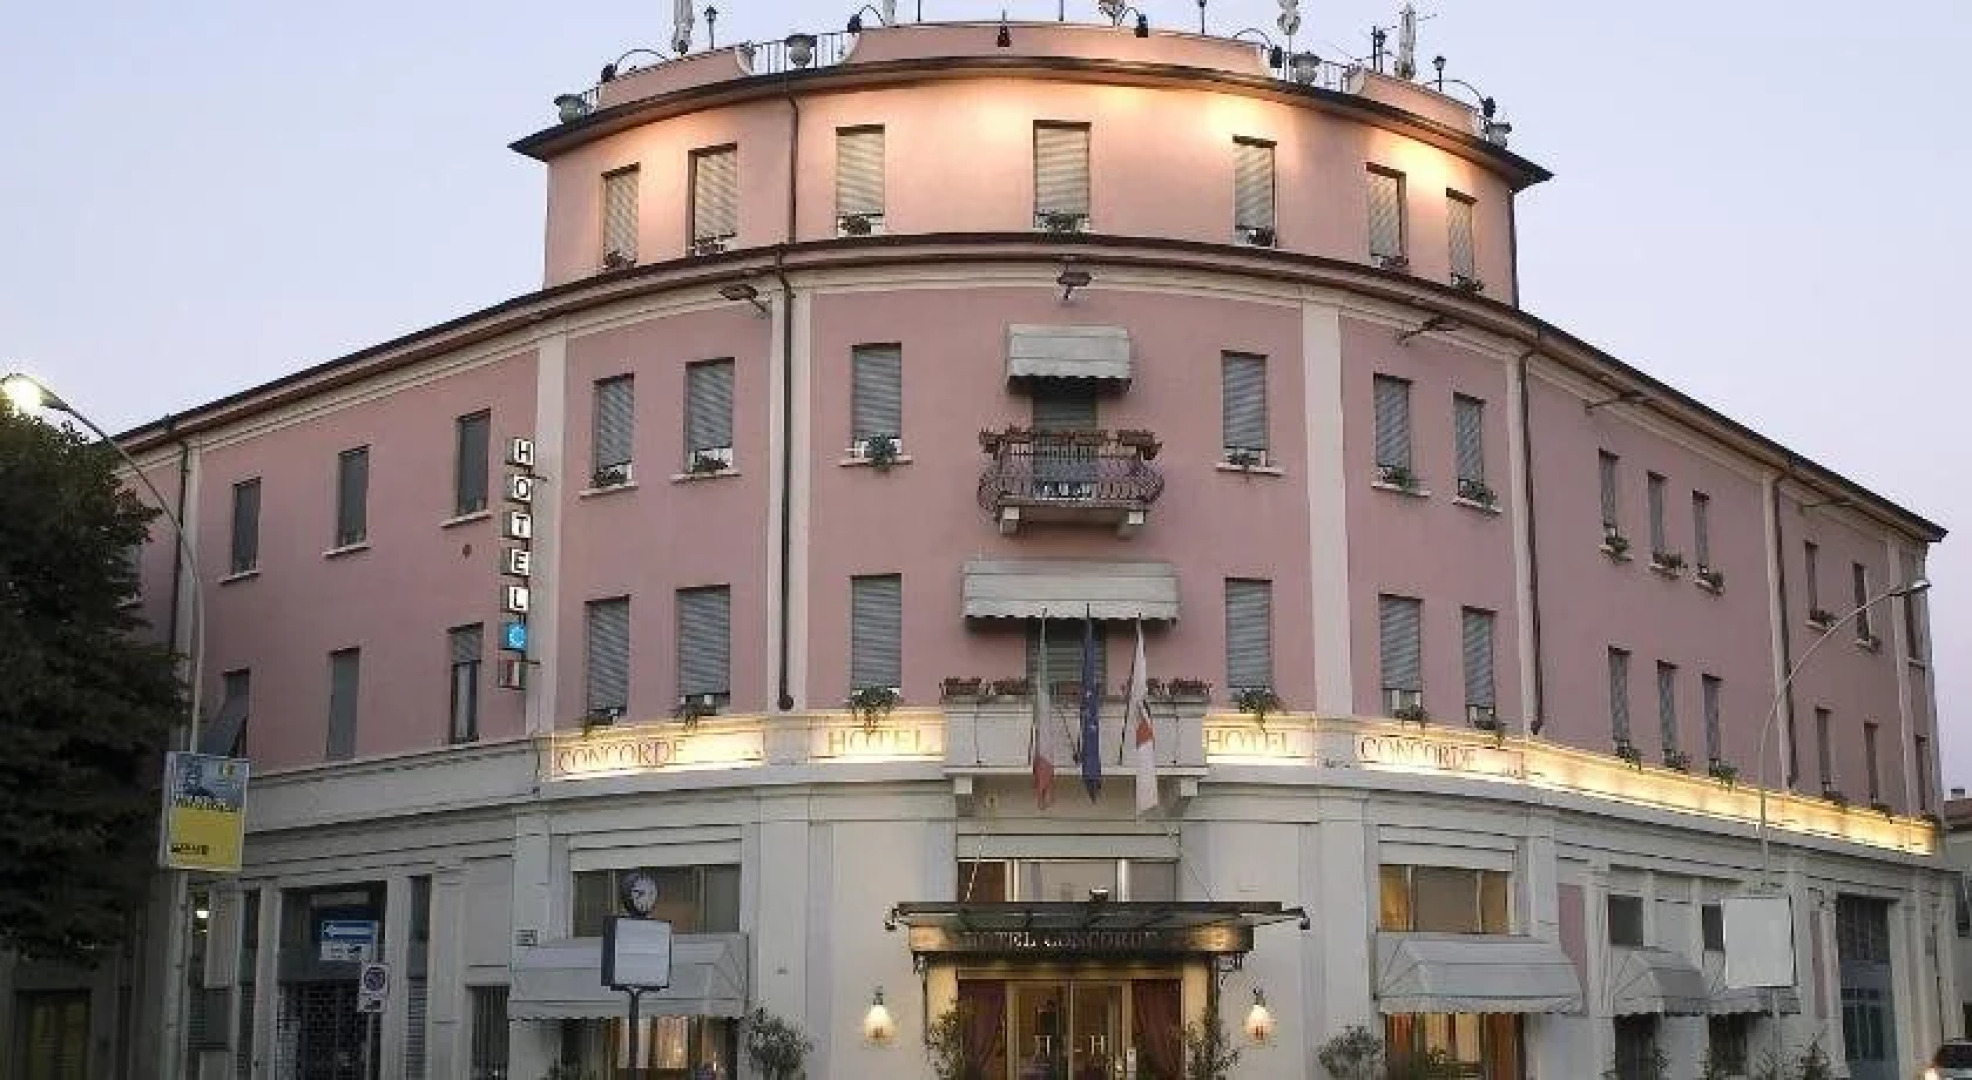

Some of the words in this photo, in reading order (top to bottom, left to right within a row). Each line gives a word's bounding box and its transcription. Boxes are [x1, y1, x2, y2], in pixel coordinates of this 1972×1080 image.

[509, 438, 533, 611] HOTEL
[558, 738, 688, 775] CONCORDE
[828, 729, 930, 755] HOTEL
[1206, 729, 1297, 755] HOTEL
[1360, 736, 1477, 773] CONCORDE
[962, 930, 1036, 948] HOTEL
